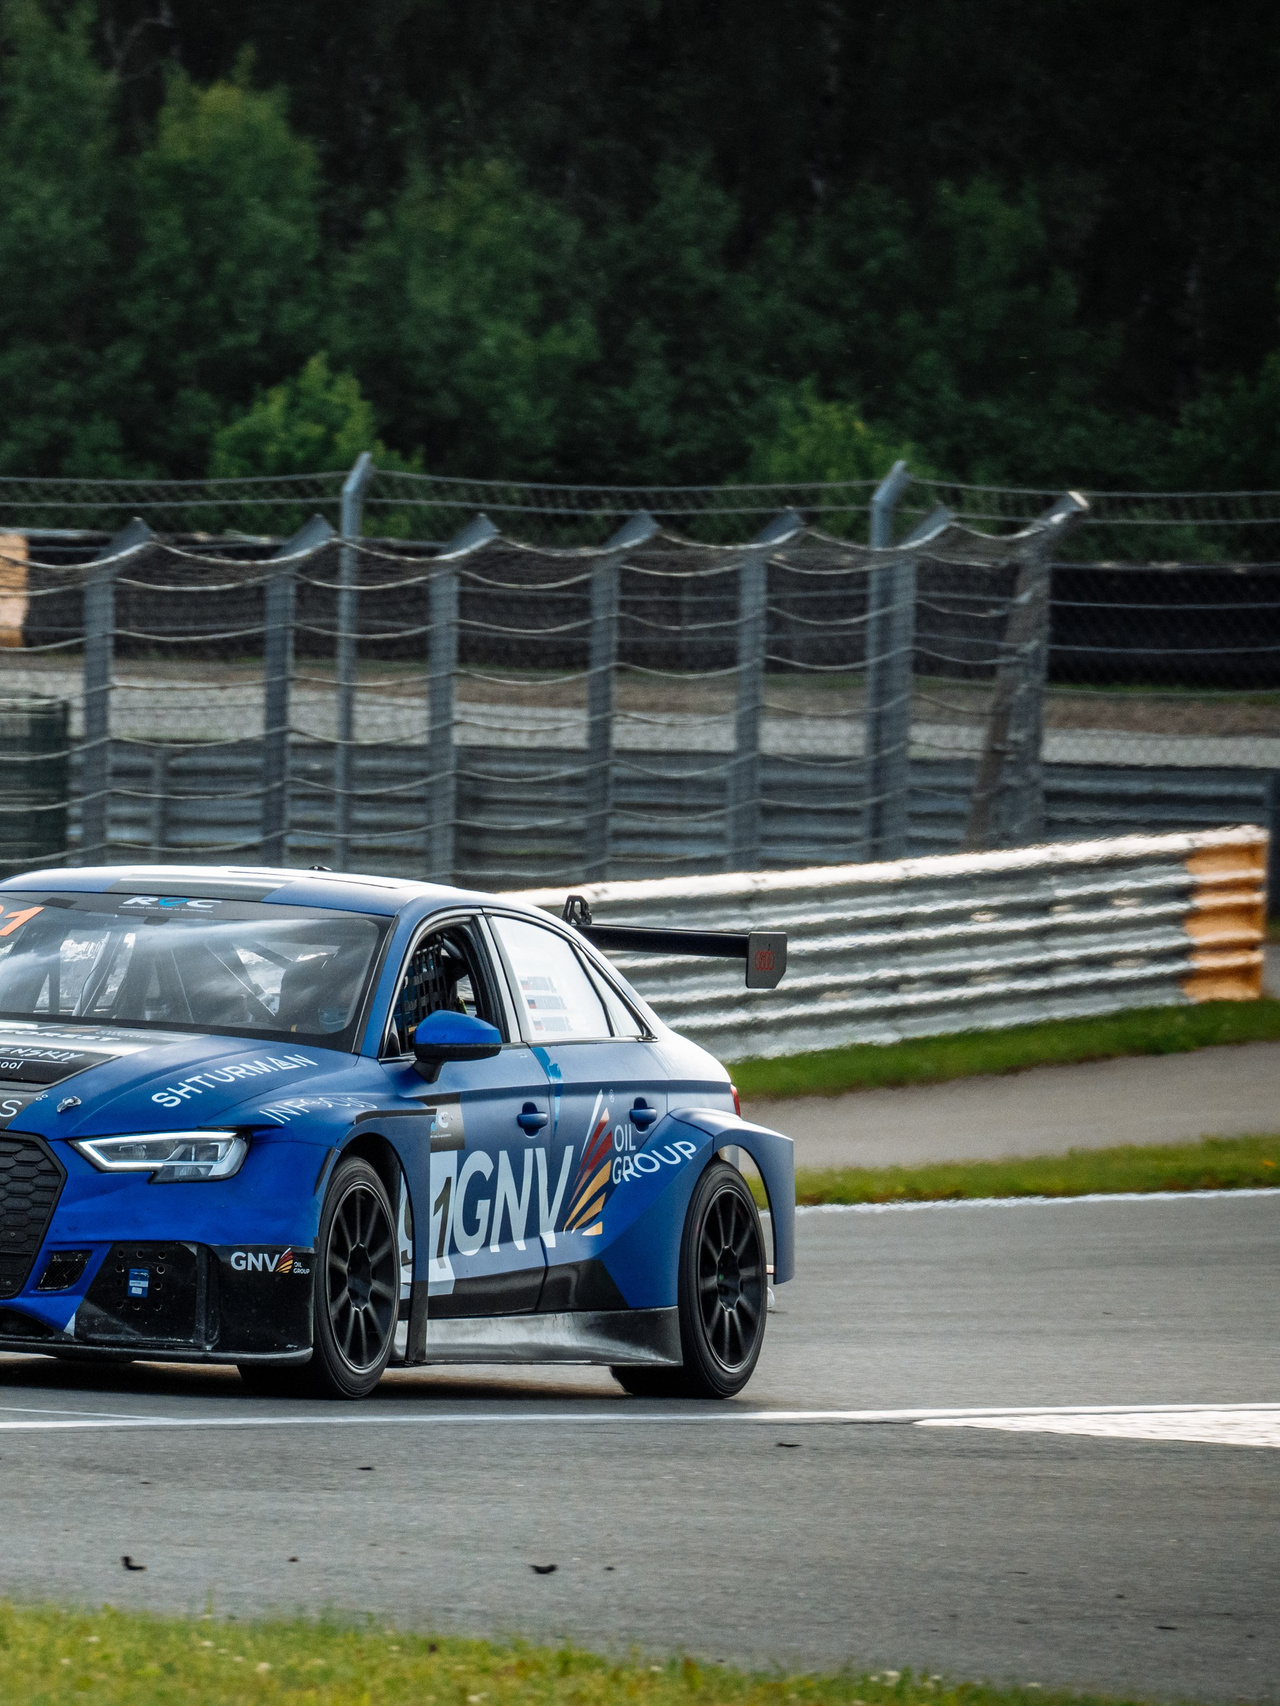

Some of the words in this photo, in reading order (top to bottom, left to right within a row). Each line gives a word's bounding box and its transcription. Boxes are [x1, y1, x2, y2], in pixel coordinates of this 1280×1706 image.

[151, 1054, 319, 1108] SHTURMAN
[613, 1123, 636, 1152] OIL
[611, 1140, 697, 1185] GROUP
[453, 1145, 574, 1257] GNV
[230, 1251, 280, 1273] GNV
